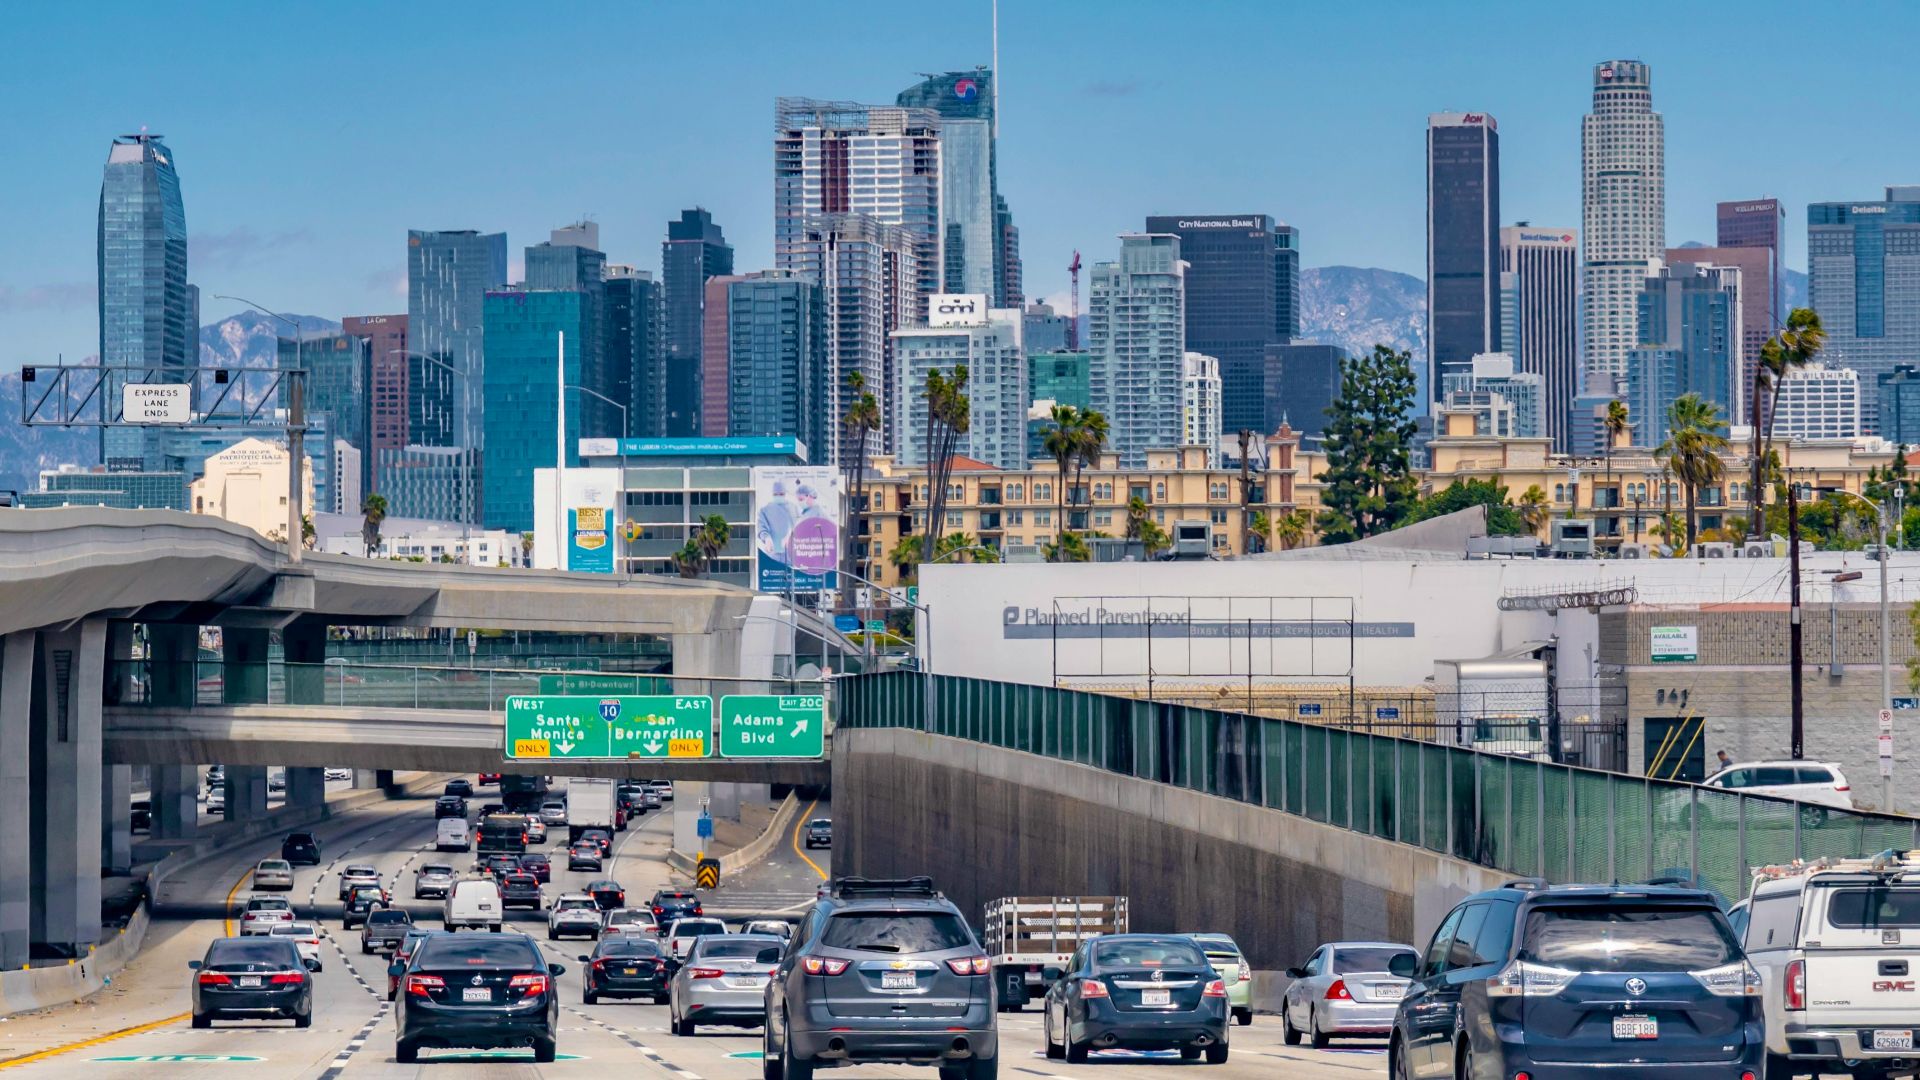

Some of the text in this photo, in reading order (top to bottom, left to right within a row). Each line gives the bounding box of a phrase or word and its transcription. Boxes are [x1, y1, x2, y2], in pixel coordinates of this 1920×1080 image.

[1463, 113, 1484, 123] AON
[1178, 219, 1253, 228] CITY NATIONAL BANK
[1802, 372, 1850, 380] WILSHIRE
[579, 508, 604, 517] BEST
[1025, 607, 1090, 626] Planned
[1190, 626, 1218, 635] BIXBY
[1262, 626, 1281, 635] FOR
[1284, 625, 1353, 635] REPRODUCTIV
[1362, 625, 1400, 635] HEALTH
[557, 680, 575, 688] Pco
[512, 699, 544, 710] WEST
[675, 699, 707, 709] EAST
[800, 698, 823, 707] 20C
[604, 705, 617, 717] 10
[536, 714, 580, 726] Santa
[647, 713, 675, 726] San
[733, 714, 784, 726] Adams
[531, 728, 584, 740] Monica
[615, 727, 704, 740] Bernardino
[741, 732, 775, 743] Blvd
[517, 744, 547, 753] ONLY
[670, 743, 700, 752] ONLY
[1008, 975, 1021, 990] R
[1872, 980, 1916, 992] GMC
